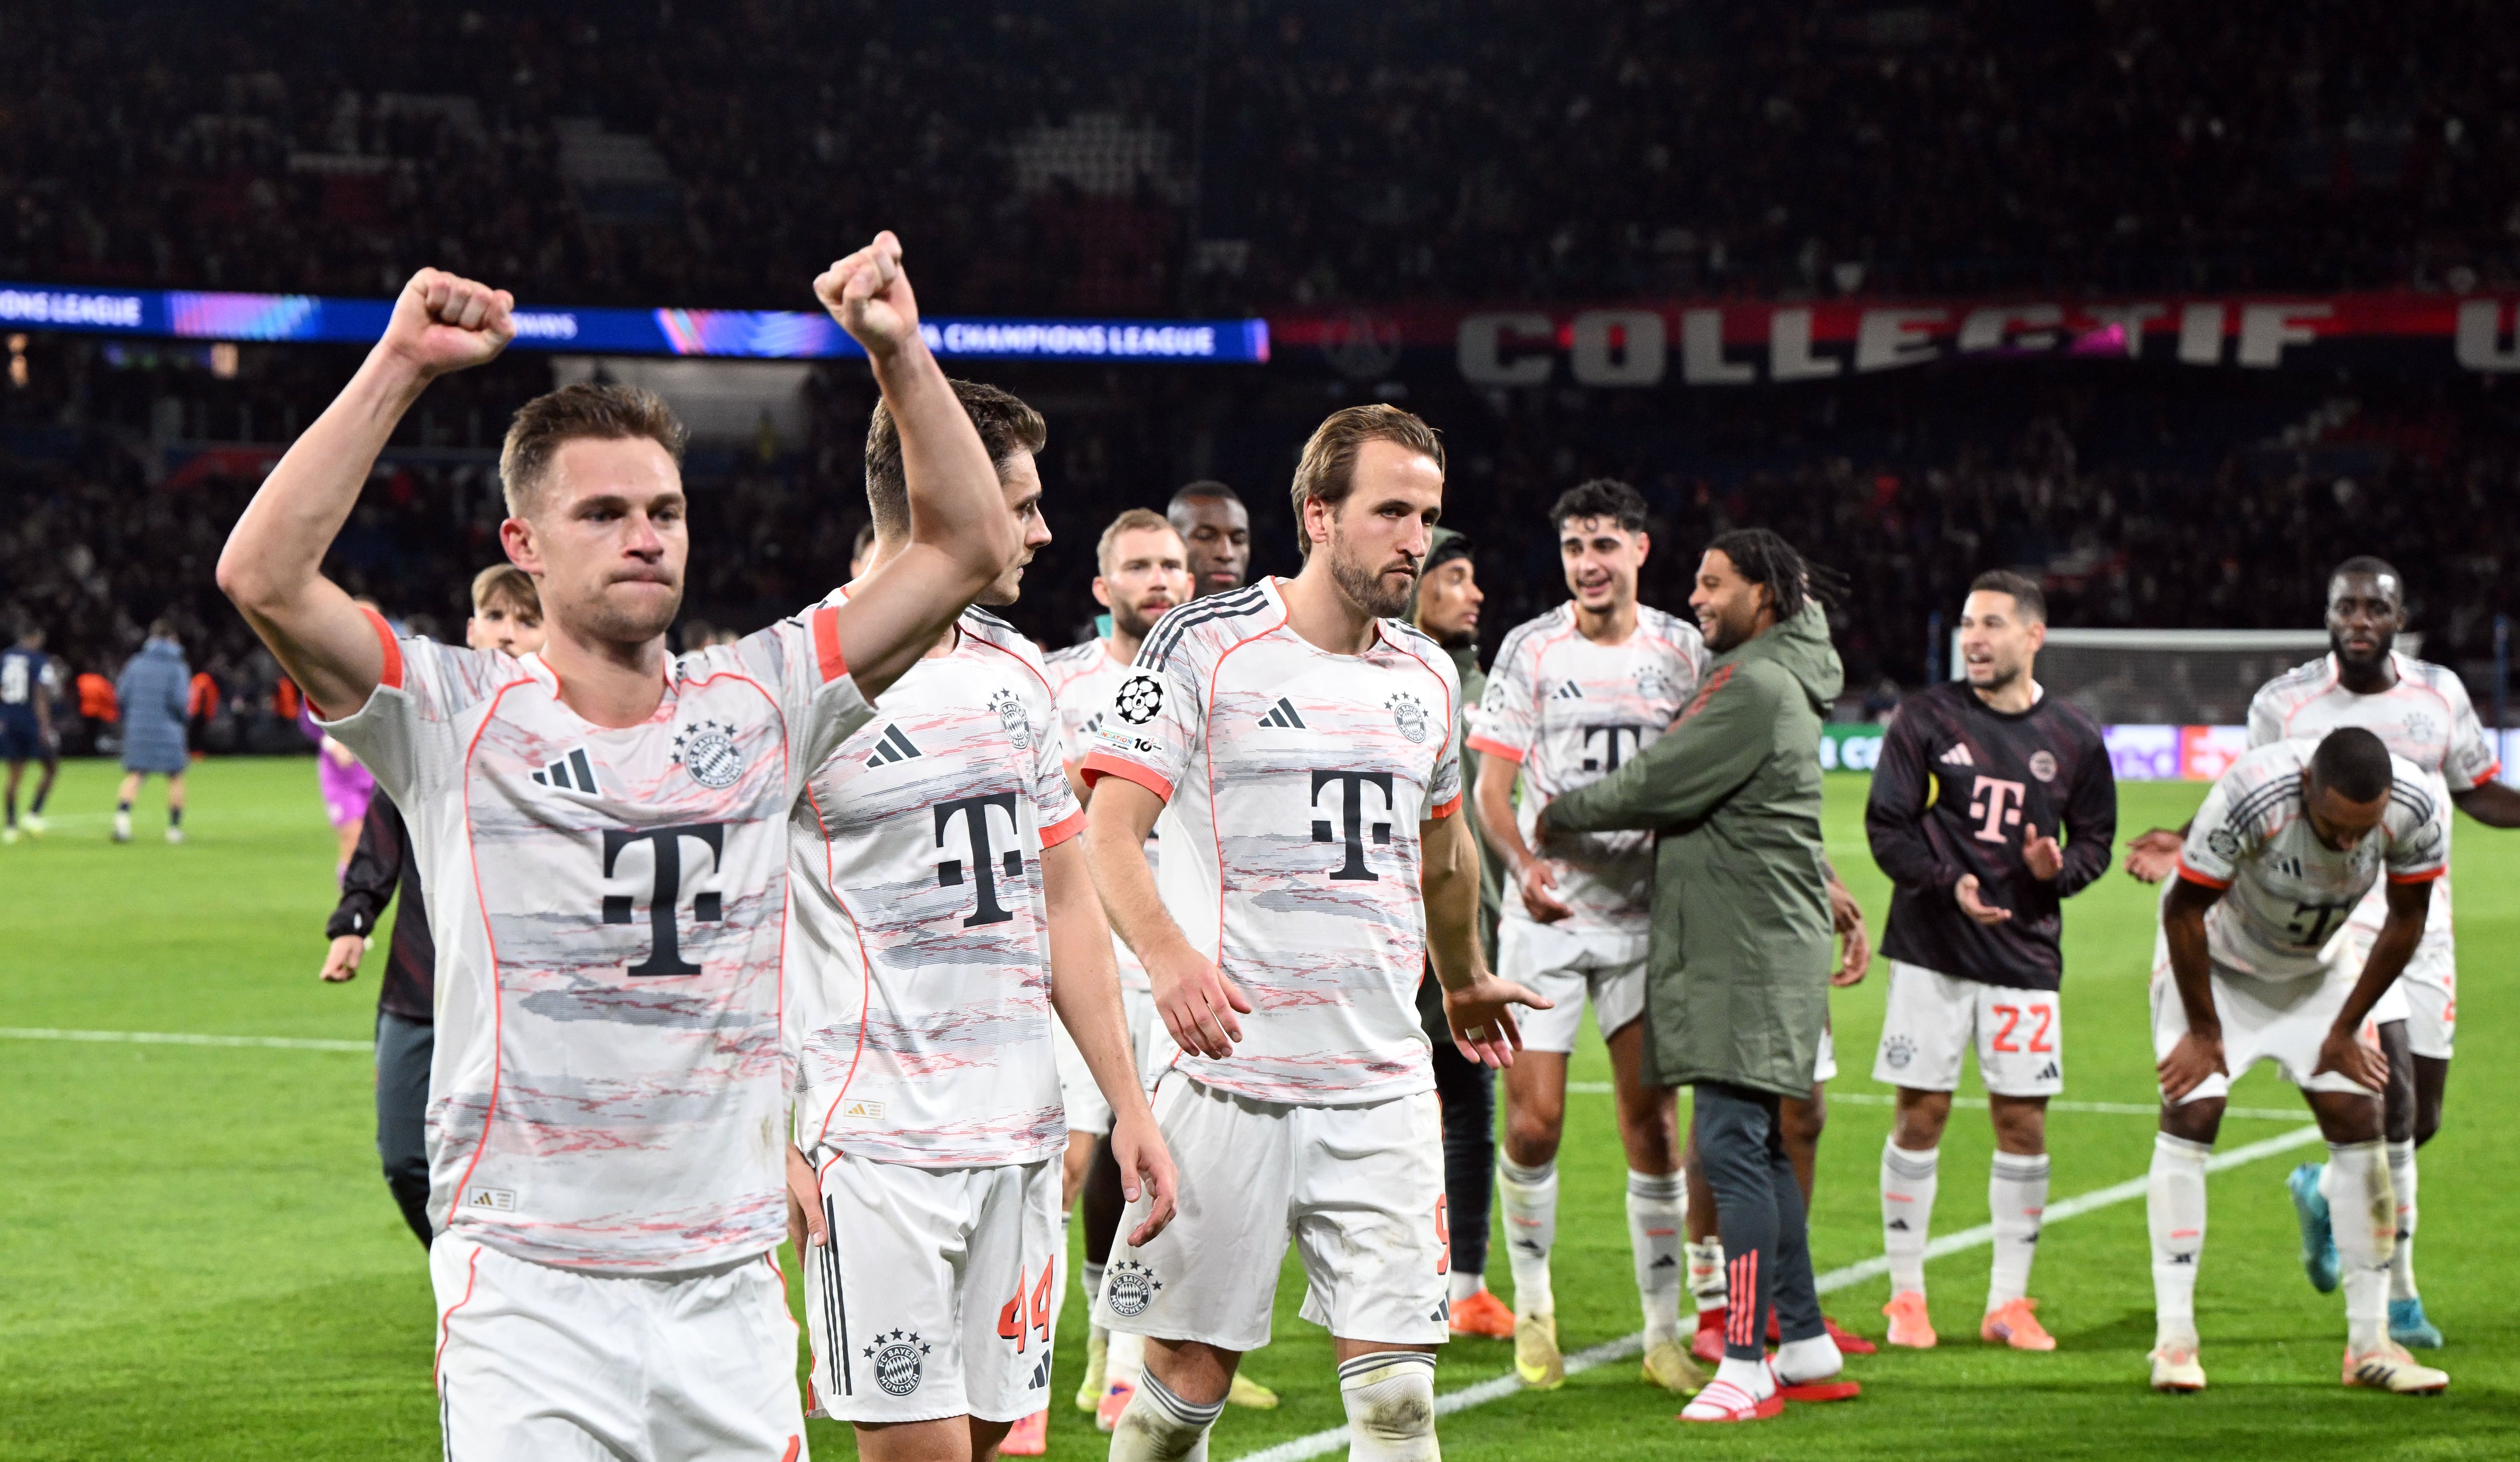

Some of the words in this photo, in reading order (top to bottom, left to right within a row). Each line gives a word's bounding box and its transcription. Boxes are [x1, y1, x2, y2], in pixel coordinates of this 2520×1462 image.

[50, 293, 142, 327] LEAGUE
[943, 323, 1107, 354] CHAMPIONS
[1108, 326, 1215, 355] LEAGUE
[1456, 302, 2333, 385] COLLECTIF
[1401, 705, 1423, 723] BAYERN
[1311, 769, 1393, 882] T
[1969, 775, 2026, 844] T
[933, 791, 1024, 928] T
[602, 822, 724, 977] T
[1992, 1003, 2053, 1053] 22
[1113, 1278, 1122, 1289] FC
[1123, 1276, 1148, 1296] BAYERN
[997, 1253, 1054, 1355] 44
[878, 1356, 888, 1368] FC
[887, 1348, 919, 1365] BAYERN
[879, 1373, 919, 1392] MÜNCHEN
